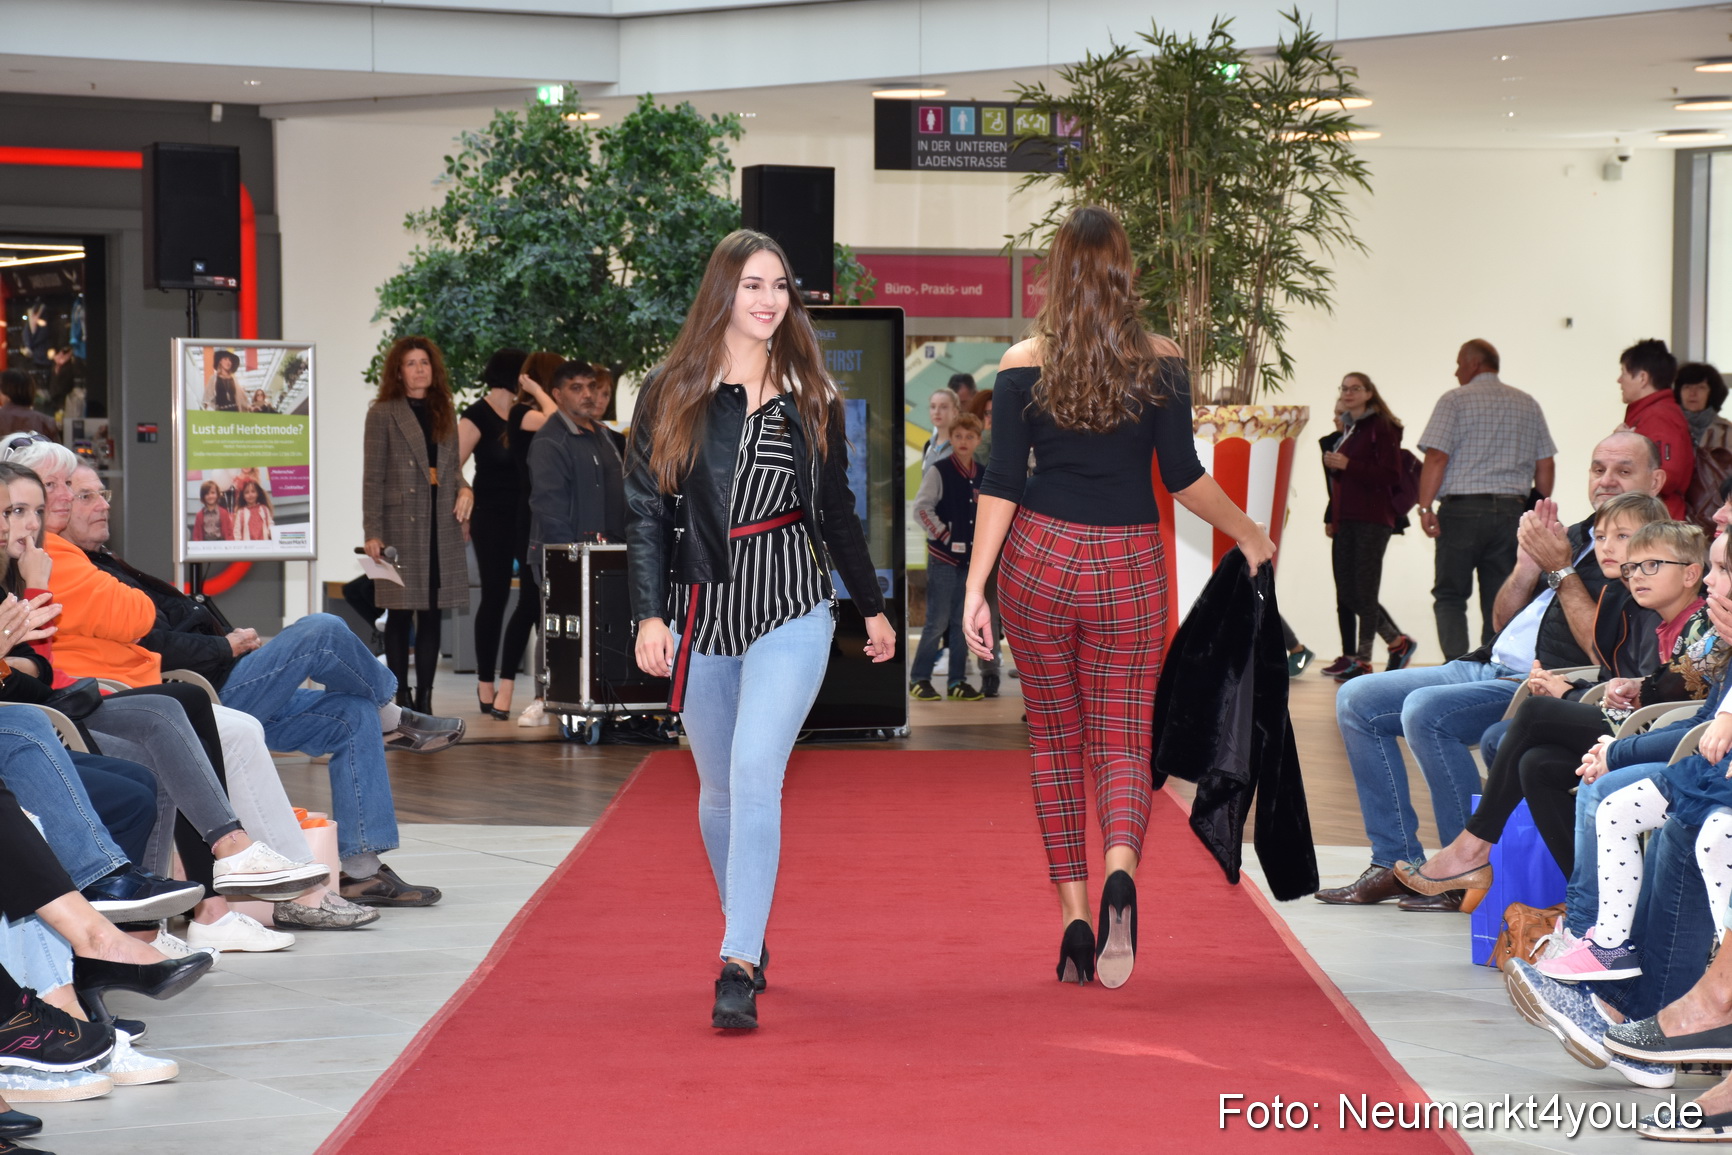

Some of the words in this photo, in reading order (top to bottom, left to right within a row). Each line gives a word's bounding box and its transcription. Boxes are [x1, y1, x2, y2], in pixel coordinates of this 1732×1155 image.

[917, 140, 928, 151] IN
[931, 140, 951, 152] DER
[955, 141, 1008, 153] UNTEREN
[917, 156, 1007, 168] LADENSTRASSE
[884, 282, 919, 296] Büro-,
[921, 283, 959, 295] Praxis-
[961, 283, 983, 296] und
[825, 349, 864, 372] FIRST
[192, 424, 215, 435] Lust
[217, 424, 235, 435] auf
[236, 424, 304, 435] Herbstmode?
